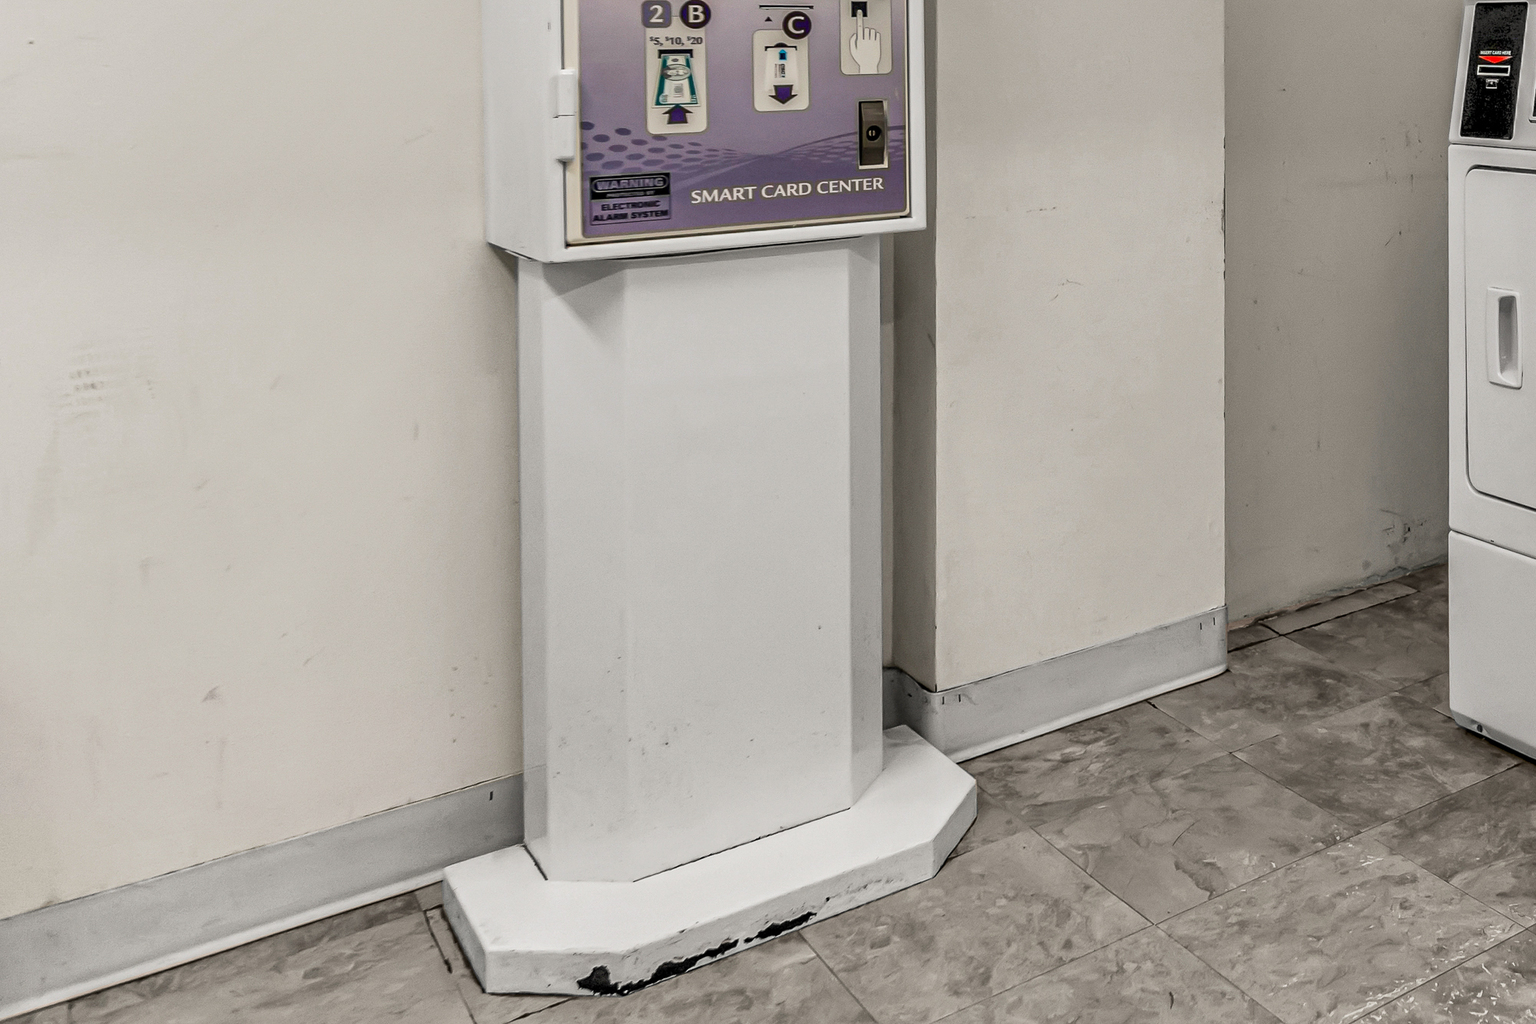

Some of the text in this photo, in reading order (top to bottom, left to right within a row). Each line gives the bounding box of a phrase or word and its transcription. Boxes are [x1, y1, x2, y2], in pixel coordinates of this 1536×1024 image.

[650, 5, 704, 23] 2 B
[788, 16, 805, 34] C
[686, 36, 703, 45] $20
[596, 177, 664, 191] WARNING
[690, 177, 884, 204] SMART CARD CENTER
[601, 200, 661, 211] ELECTRONIC
[593, 209, 669, 222] ALARM SYSTEM
